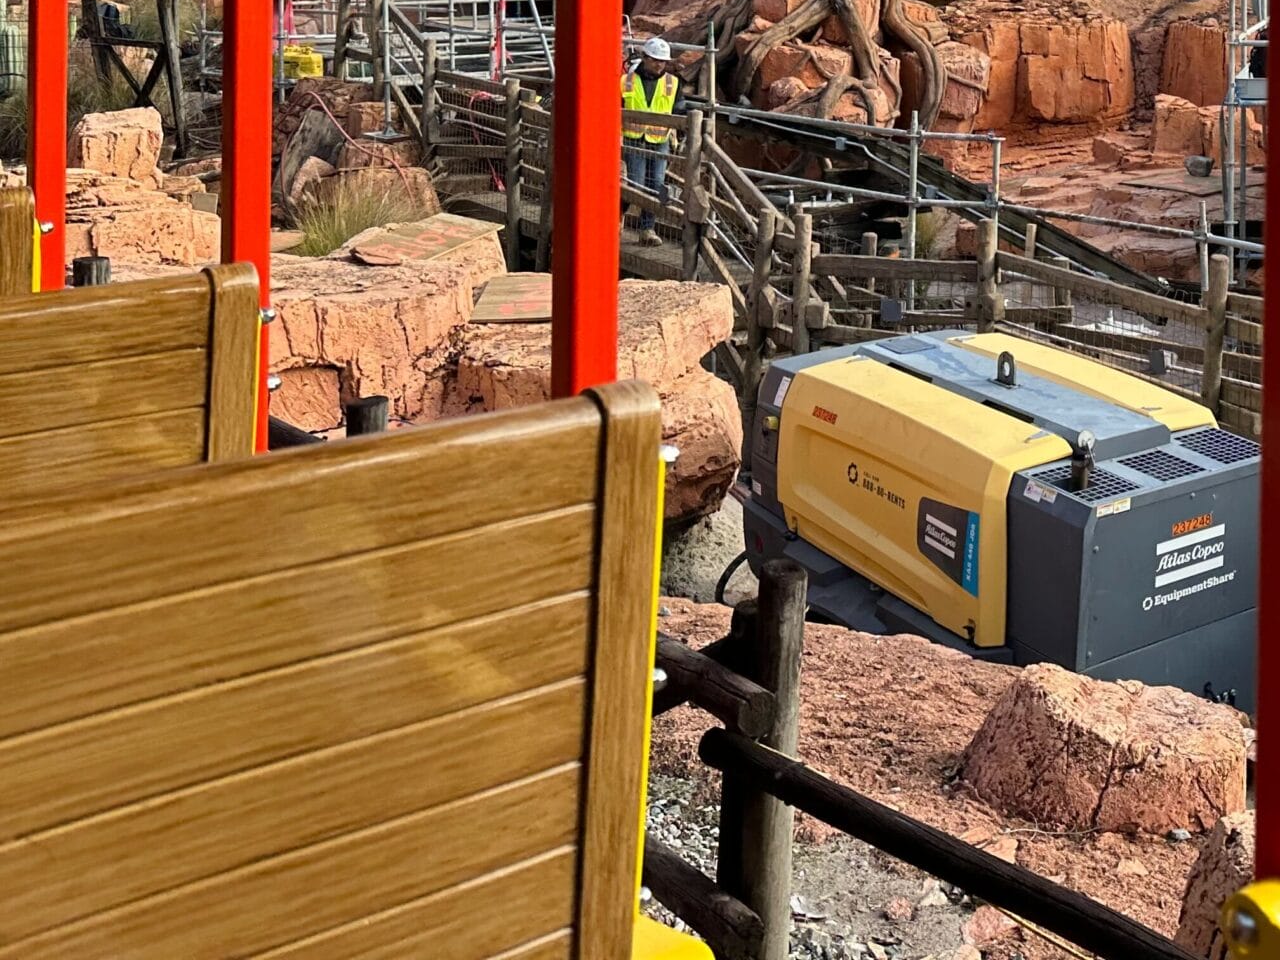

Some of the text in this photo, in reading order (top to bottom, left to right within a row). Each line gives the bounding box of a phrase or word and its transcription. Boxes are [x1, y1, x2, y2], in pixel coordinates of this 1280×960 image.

[1172, 513, 1212, 535] 237248
[1155, 541, 1225, 573] Atlas Copco
